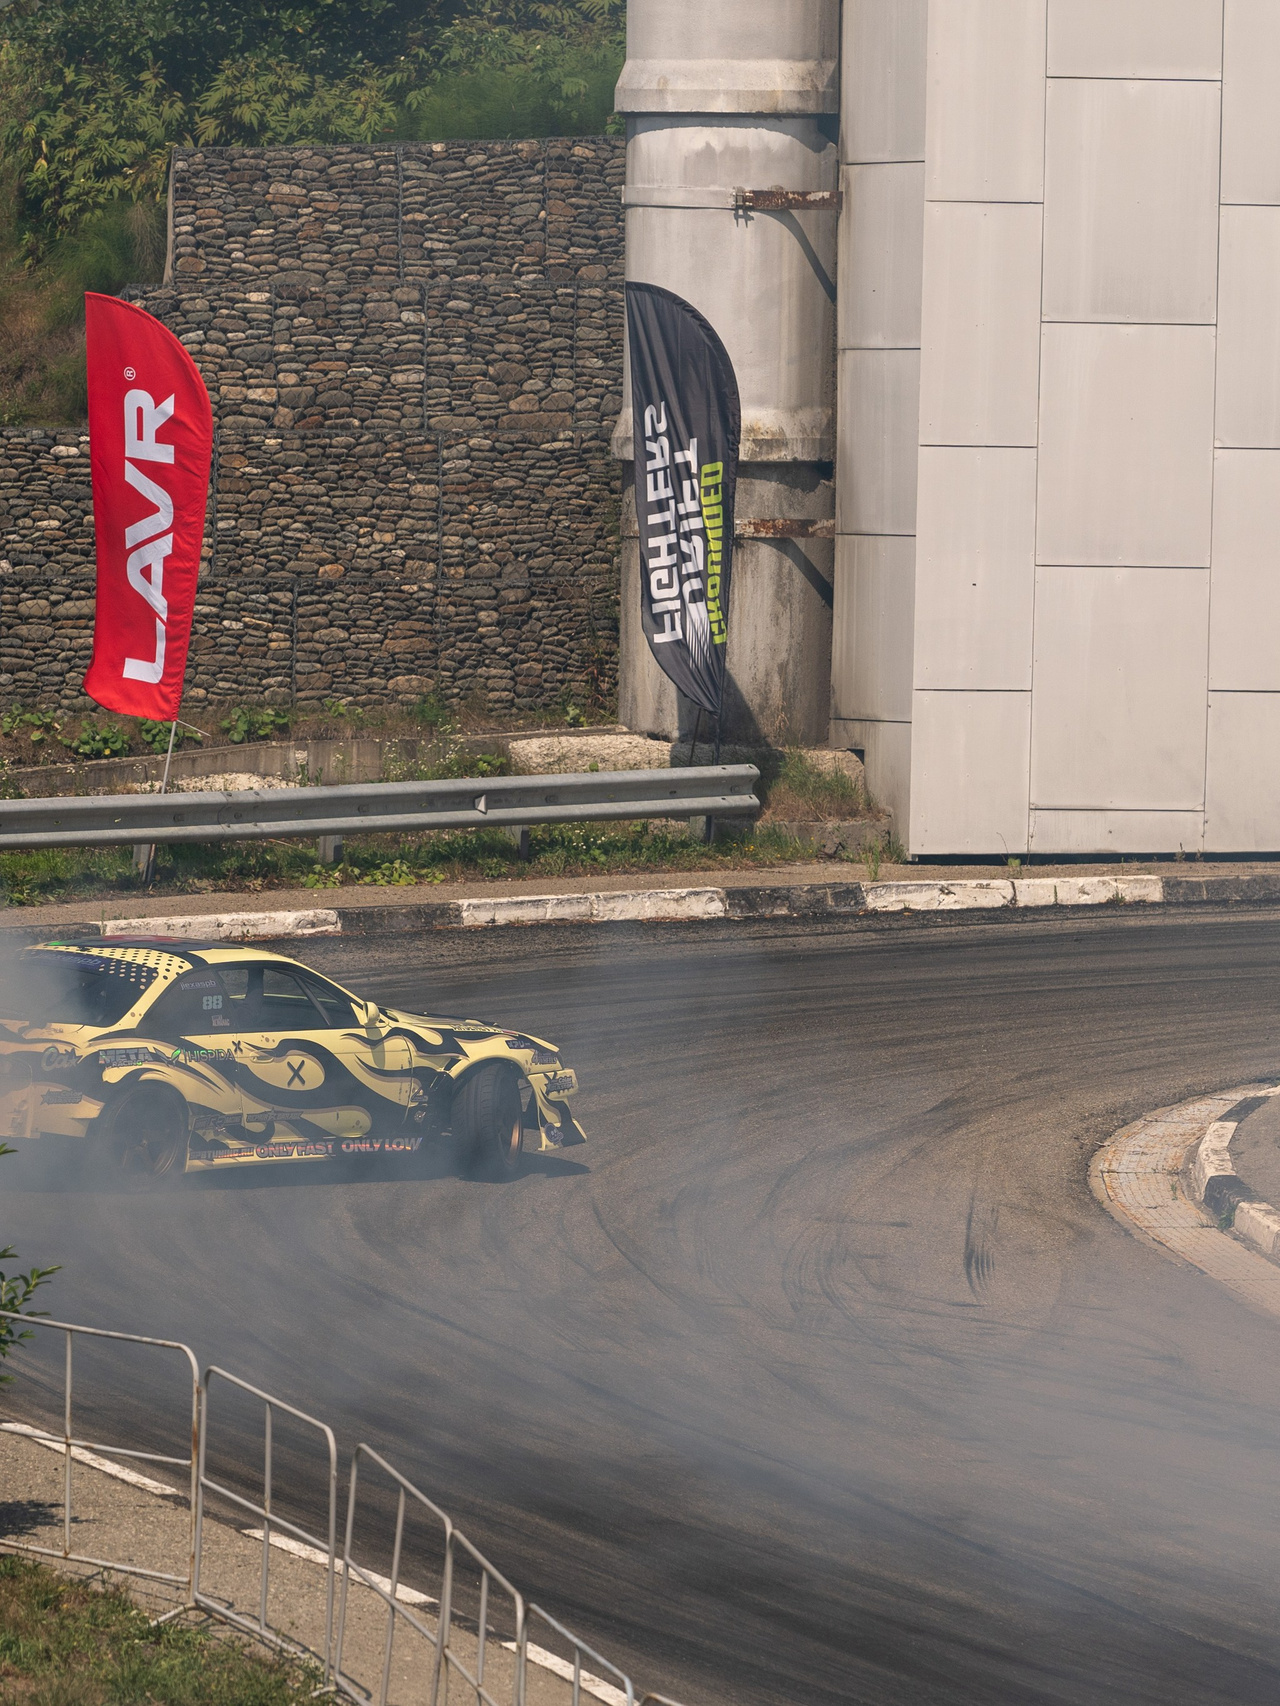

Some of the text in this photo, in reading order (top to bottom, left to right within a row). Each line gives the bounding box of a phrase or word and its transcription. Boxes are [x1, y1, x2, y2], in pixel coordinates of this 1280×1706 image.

[202, 995, 223, 1010] 88
[99, 1048, 154, 1064] META
[256, 1143, 297, 1158] ONLY
[296, 1141, 334, 1156] FAST
[342, 1139, 383, 1153] ONLY
[385, 1137, 422, 1152] LOW
